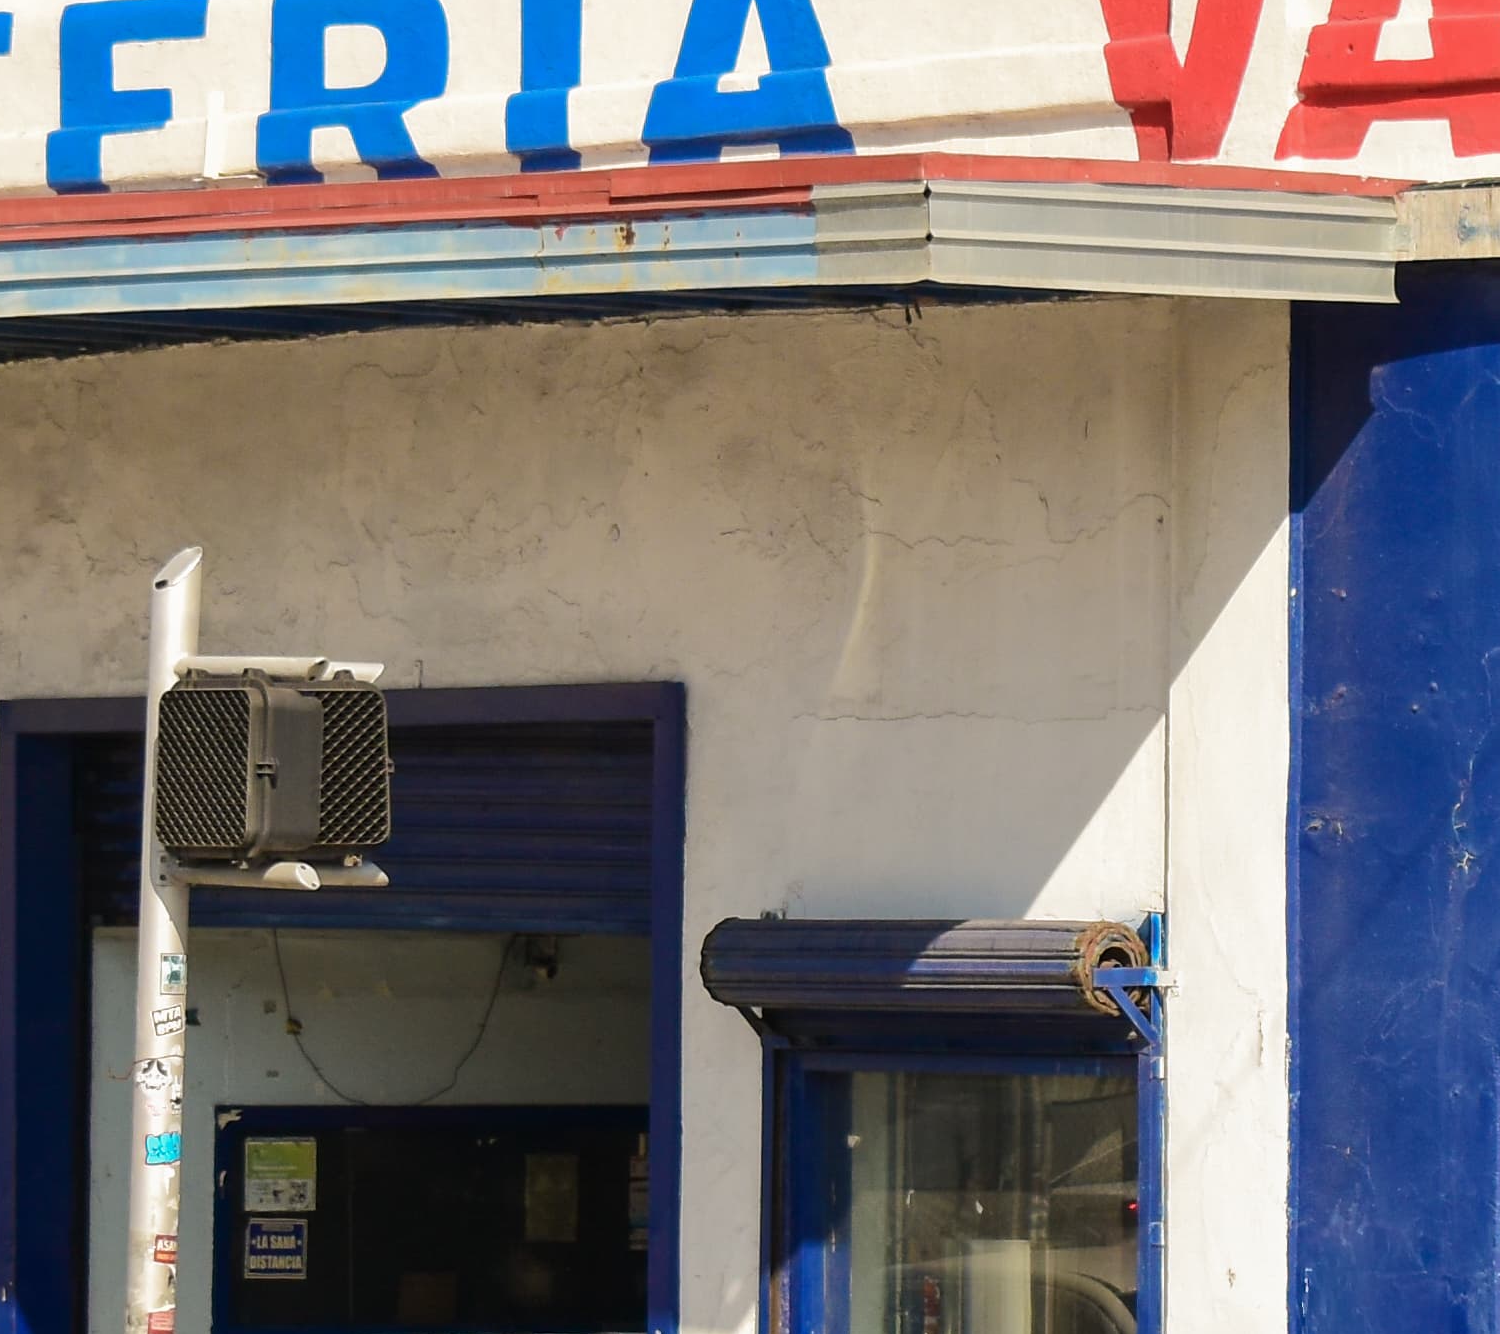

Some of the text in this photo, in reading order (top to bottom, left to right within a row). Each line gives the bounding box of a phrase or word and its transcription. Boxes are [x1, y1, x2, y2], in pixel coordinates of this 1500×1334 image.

[257, 1236, 296, 1249] LA SANA
[250, 1255, 303, 1270] DISTANCIA
